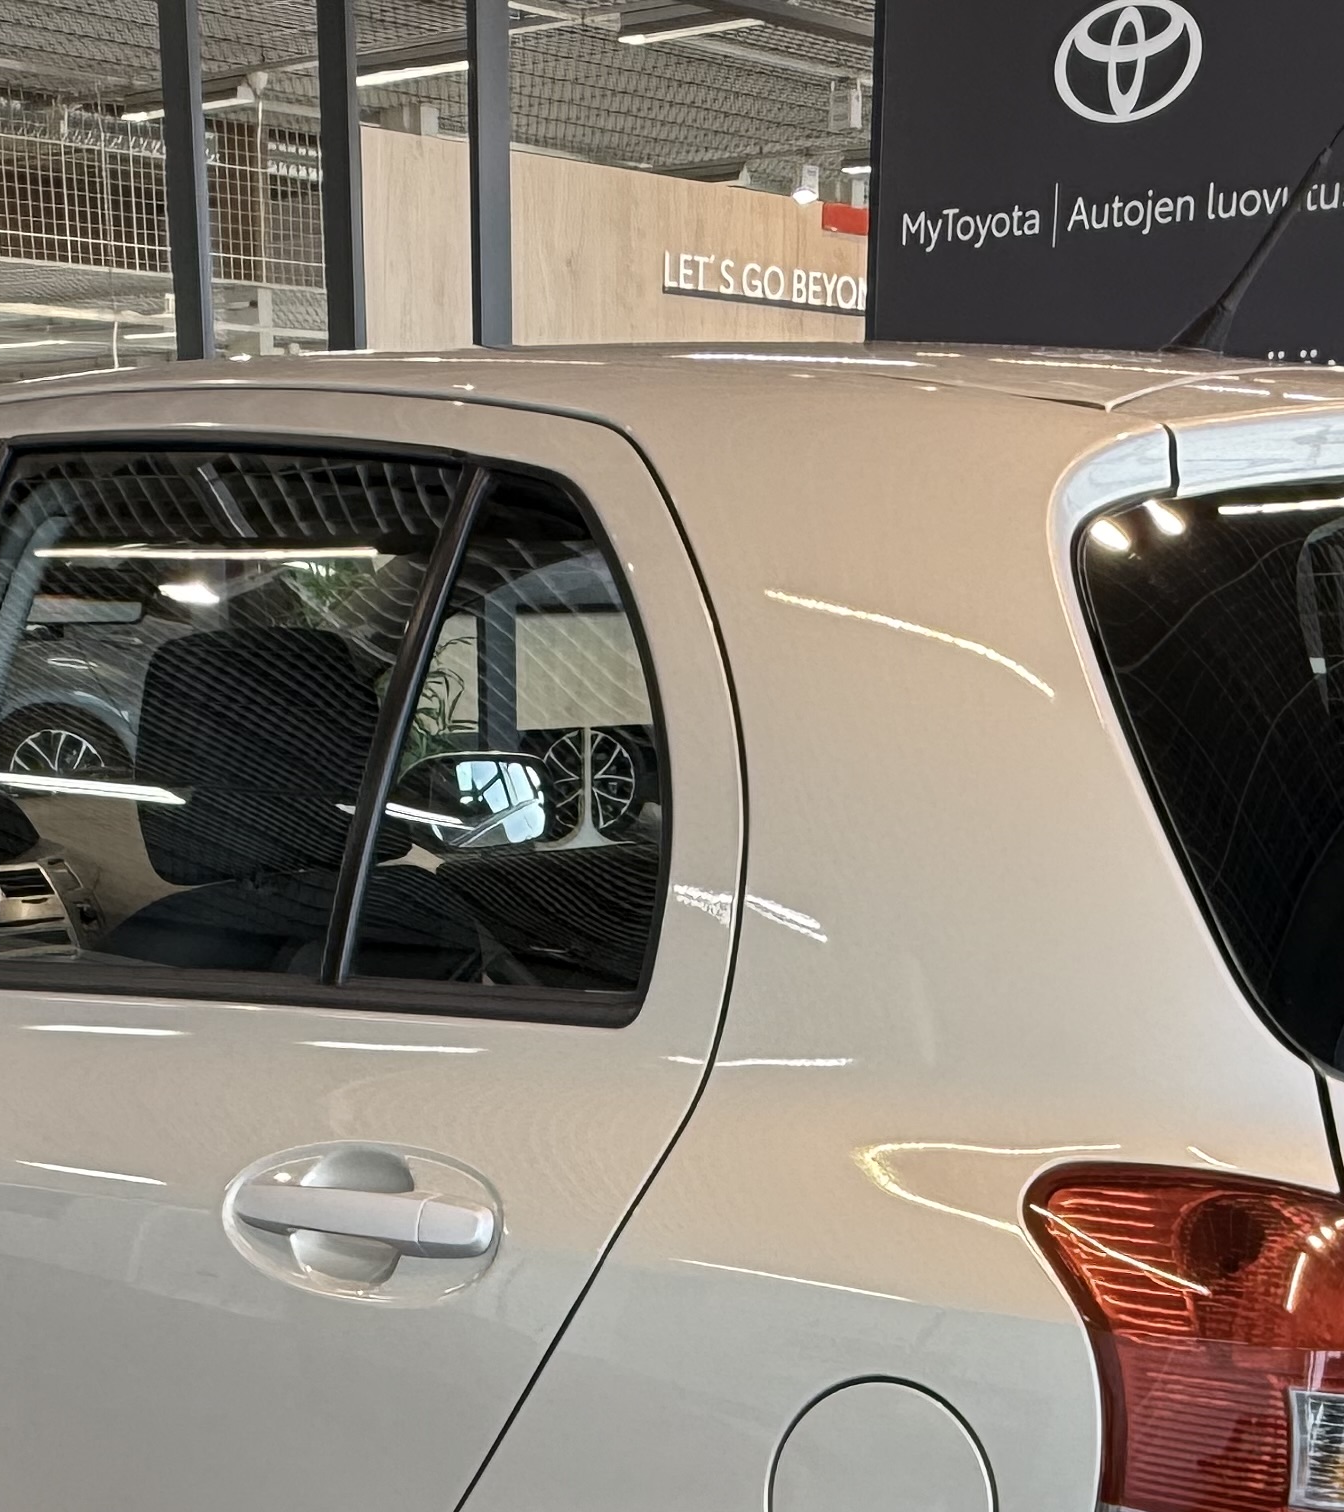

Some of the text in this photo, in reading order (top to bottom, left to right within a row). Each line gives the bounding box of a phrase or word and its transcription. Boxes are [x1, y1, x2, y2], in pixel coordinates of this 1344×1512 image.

[901, 205, 1041, 253] MyToyota
[1067, 188, 1196, 235] Autojen
[742, 263, 785, 300] GO
